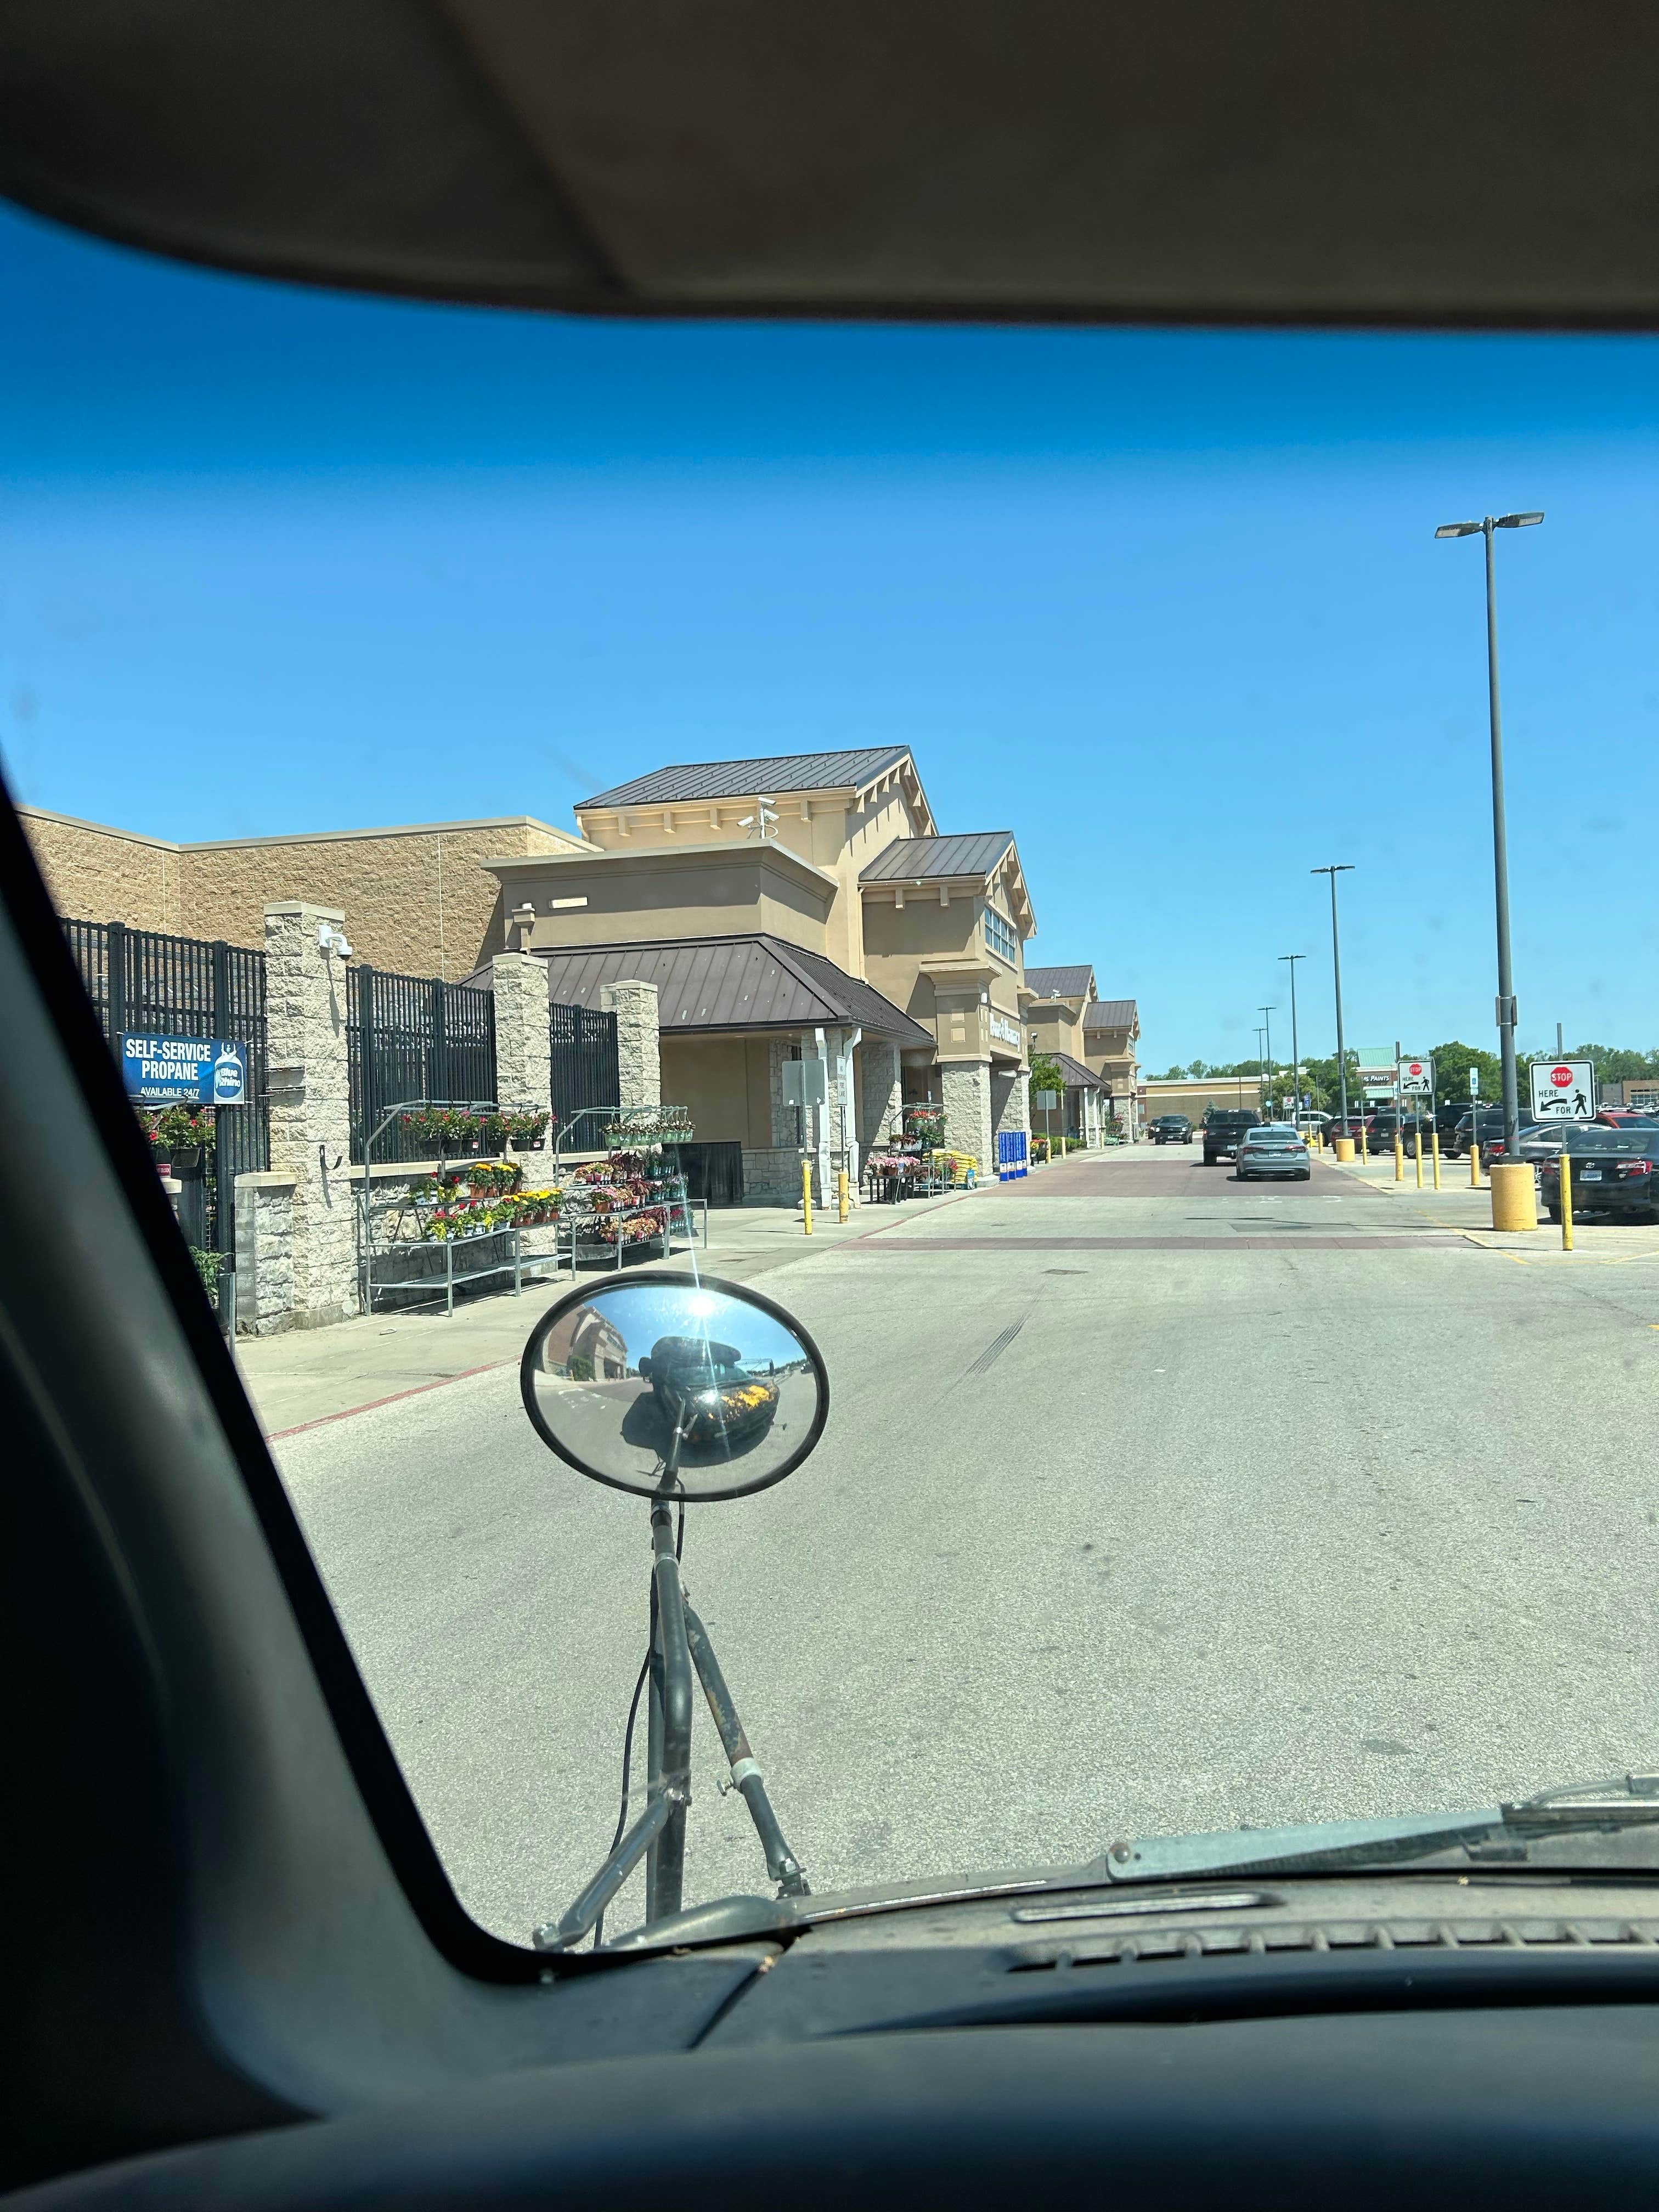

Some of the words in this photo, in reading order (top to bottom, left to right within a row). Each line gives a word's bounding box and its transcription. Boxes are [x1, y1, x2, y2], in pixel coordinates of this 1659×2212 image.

[126, 1039, 211, 1062] SELF-SERVICE
[142, 1060, 199, 1080] PROPANE
[221, 1068, 238, 1077] Blue
[219, 1076, 241, 1087] Rhino
[1551, 1073, 1572, 1081] STOP
[140, 1087, 182, 1096] AVAILABLE
[183, 1088, 199, 1097] 24/7
[1538, 1090, 1559, 1098] HERE
